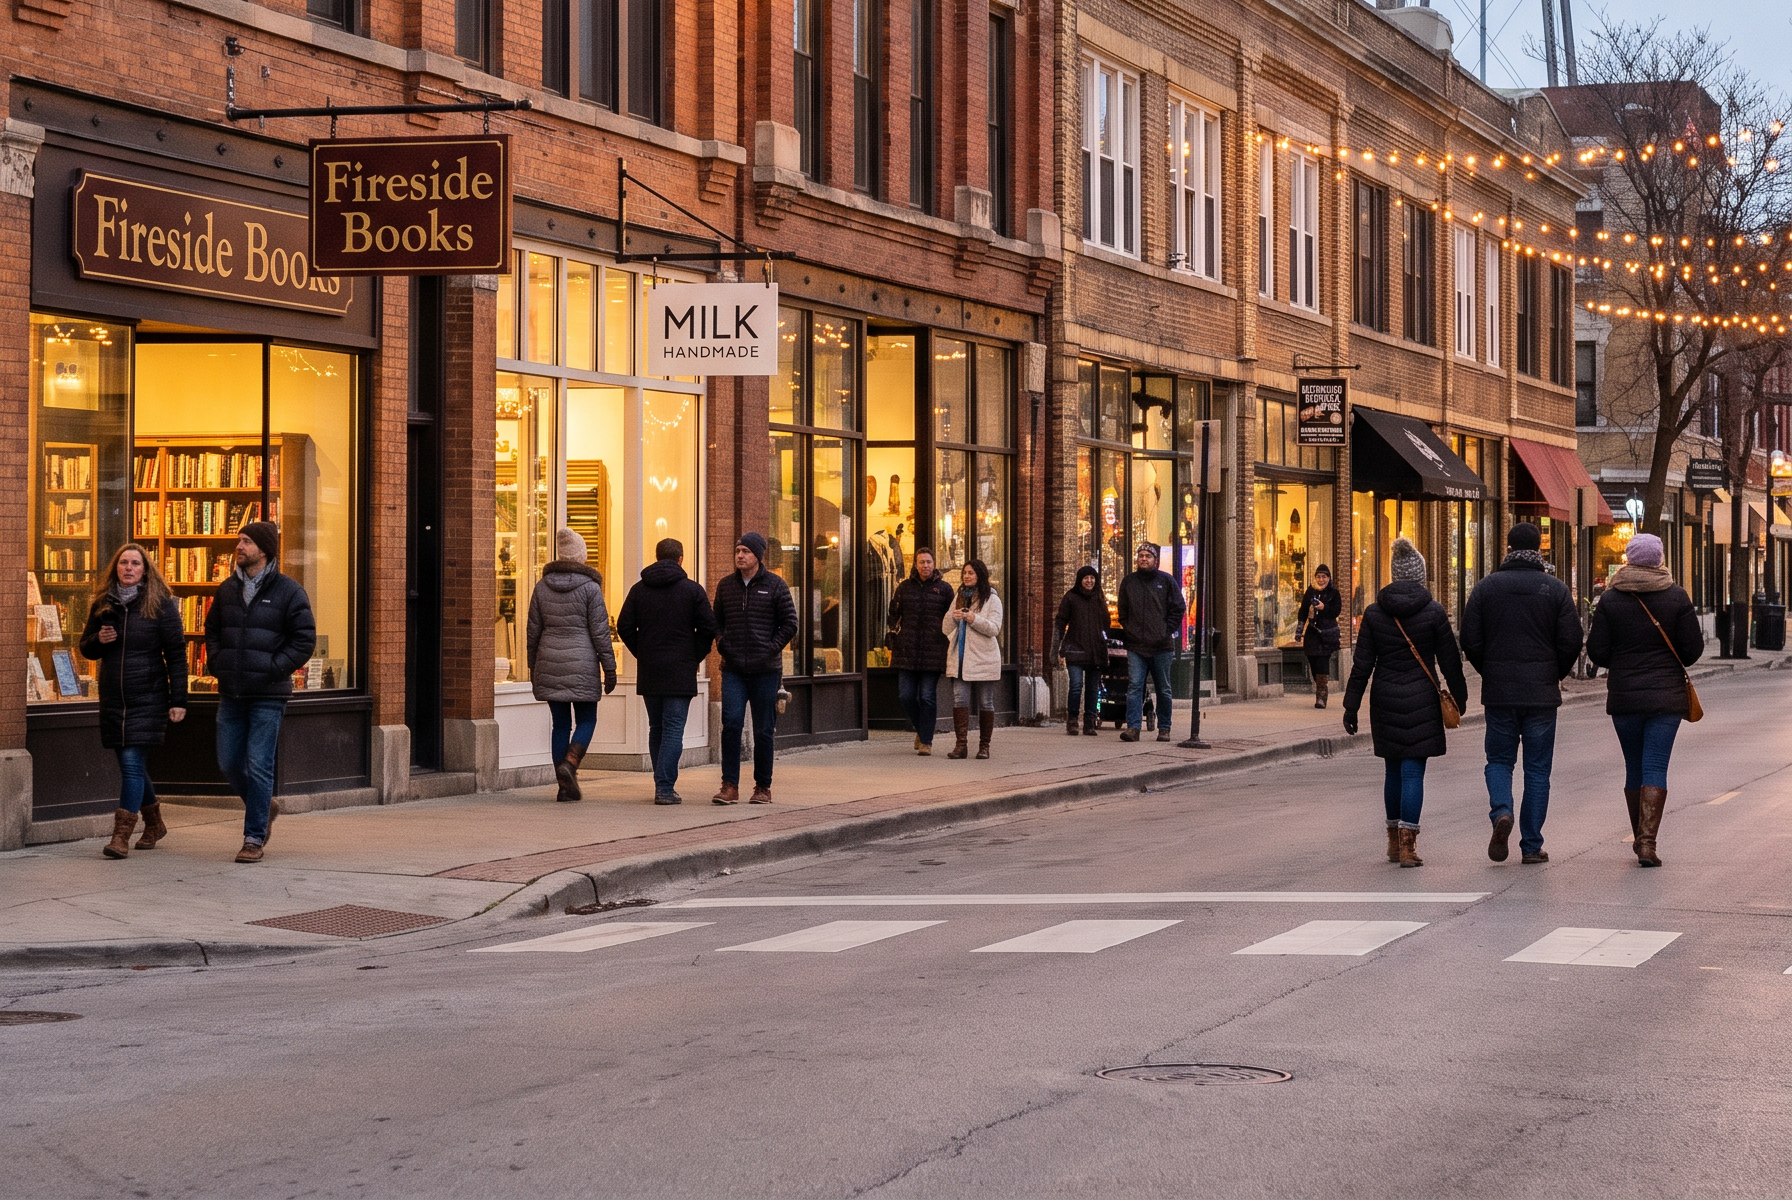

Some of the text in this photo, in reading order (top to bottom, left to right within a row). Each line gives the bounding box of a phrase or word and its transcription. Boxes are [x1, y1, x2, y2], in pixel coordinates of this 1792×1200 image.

[323, 155, 494, 203] Fireside
[93, 194, 233, 278] Fireside
[340, 207, 474, 253] Books
[664, 304, 759, 340] MILK
[663, 346, 759, 358] HANDMADE
